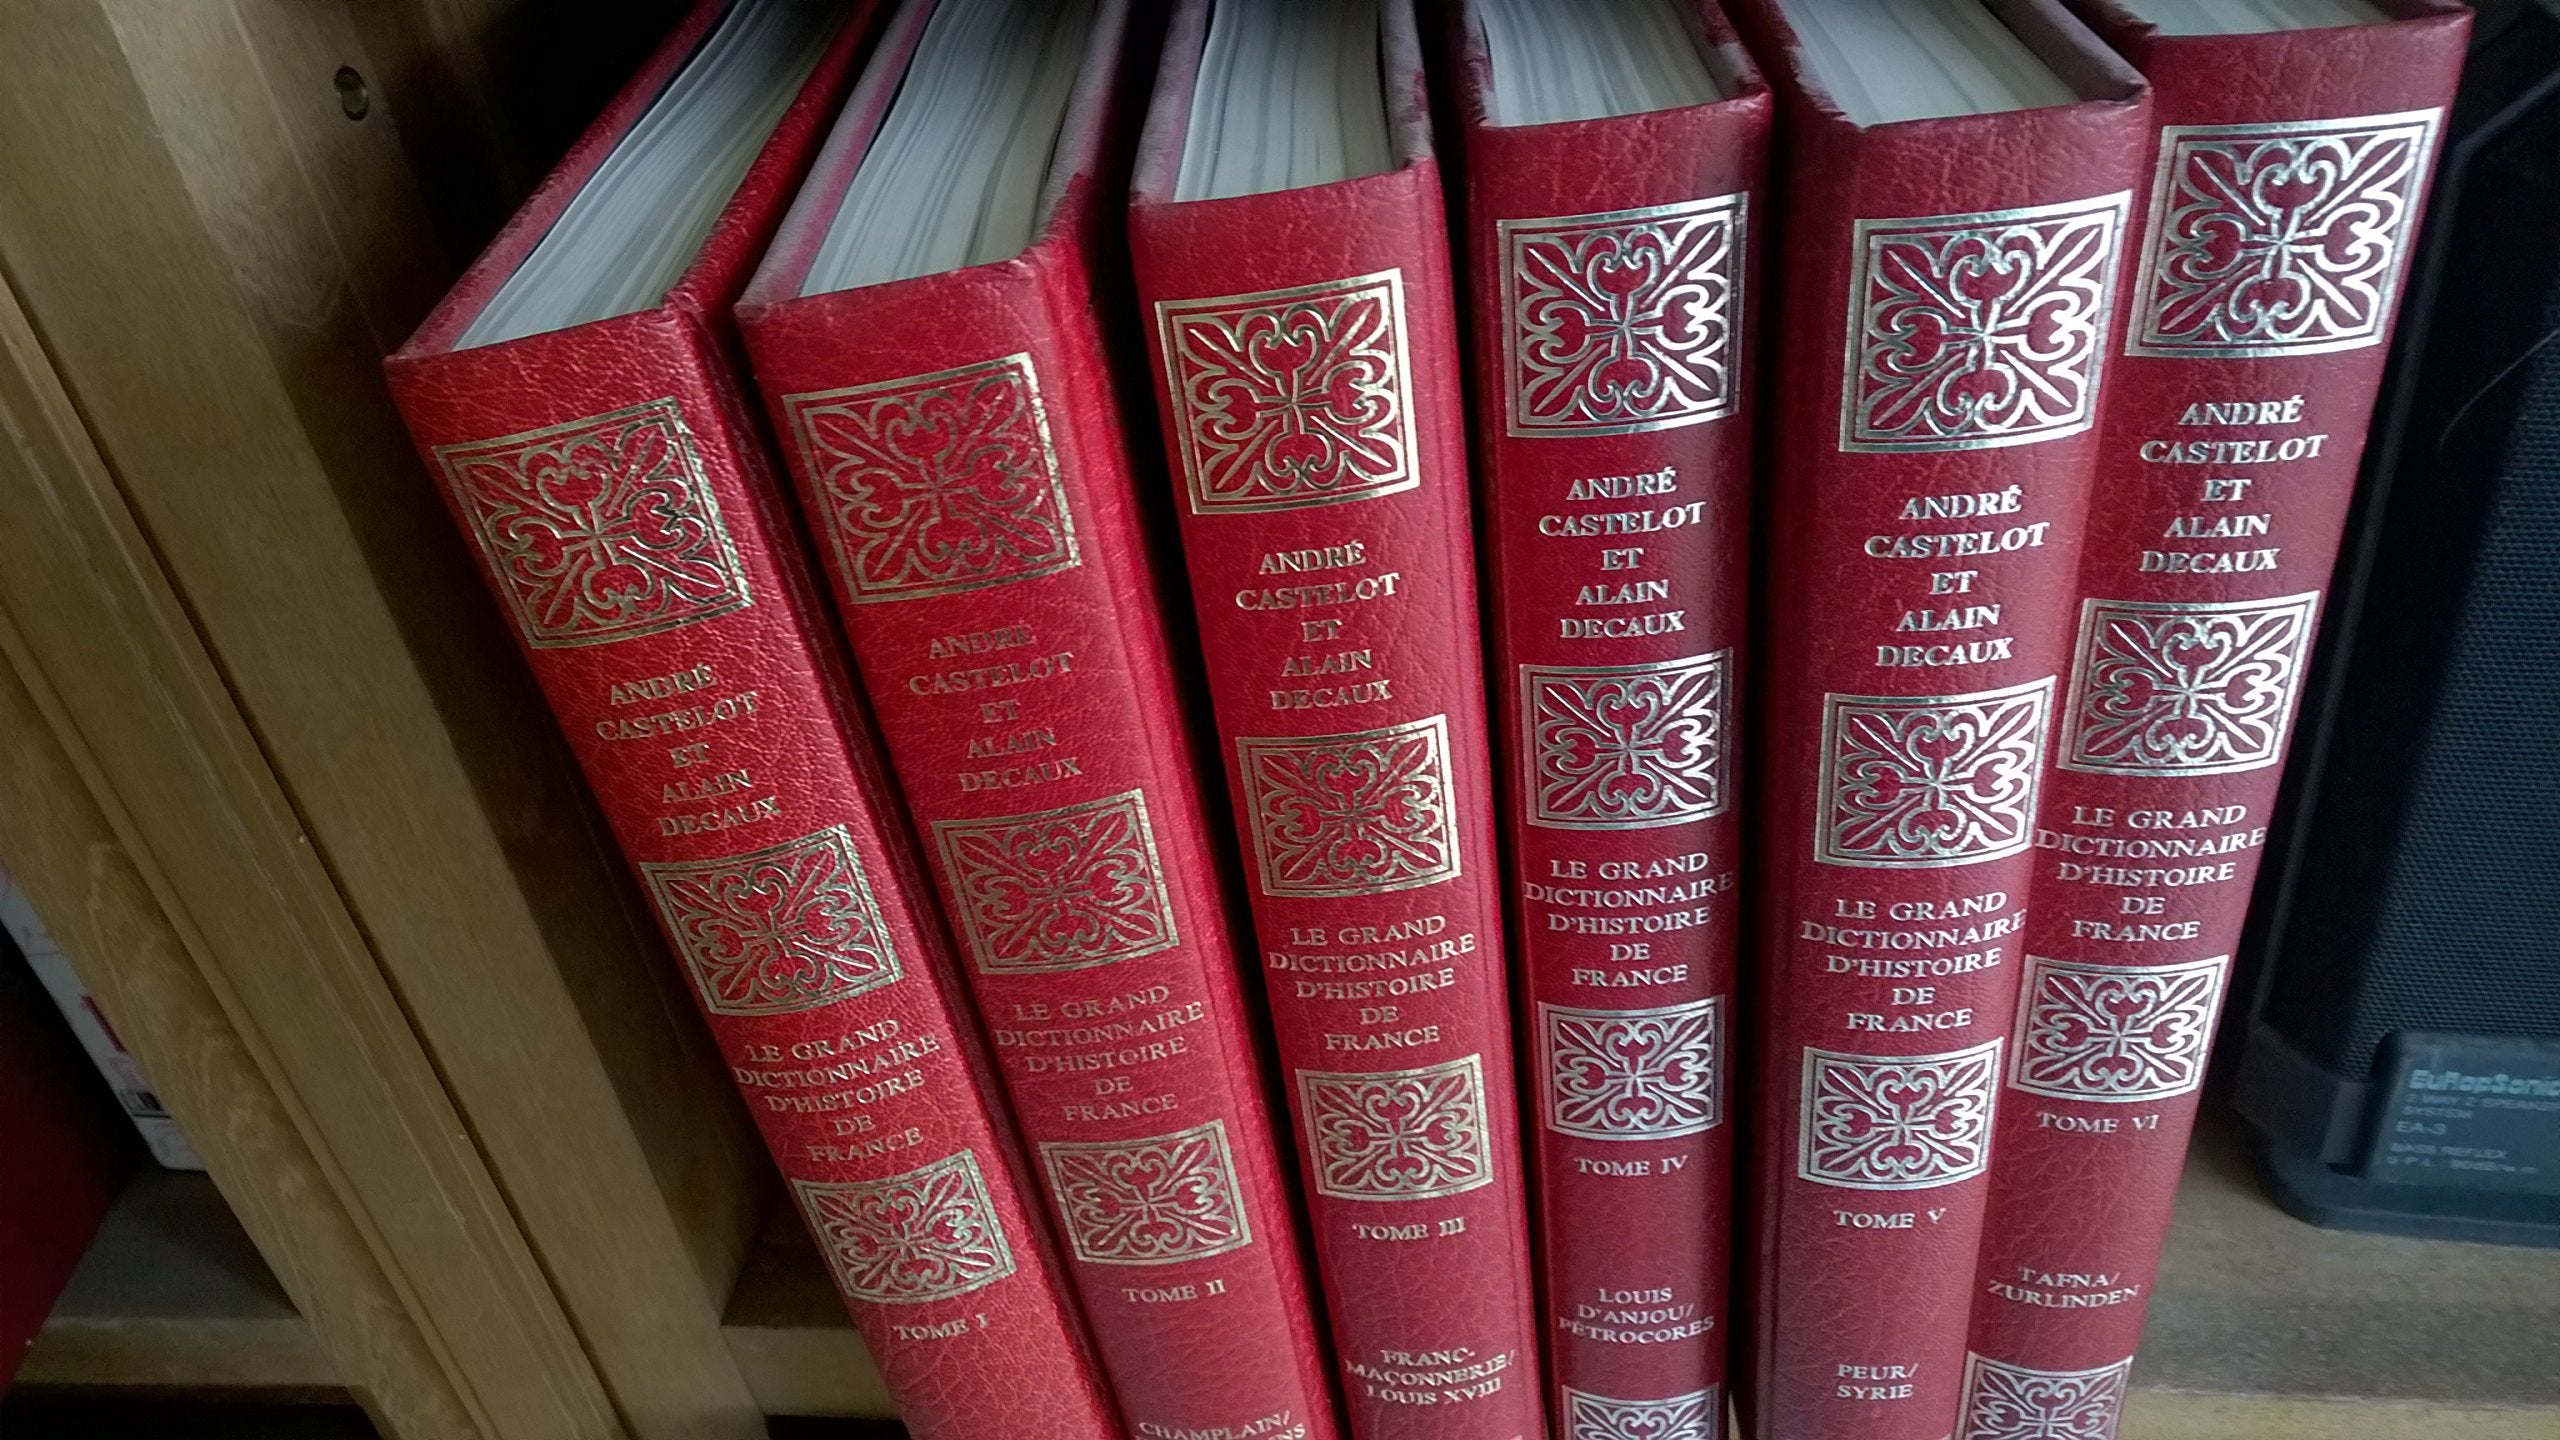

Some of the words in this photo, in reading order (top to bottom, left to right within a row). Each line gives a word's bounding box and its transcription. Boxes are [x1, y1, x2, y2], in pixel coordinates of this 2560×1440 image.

[2178, 394, 2305, 426] ANDRÉ
[2139, 434, 2329, 464] CASTELOT
[1565, 465, 1678, 501] ANDRÉ
[2201, 479, 2252, 502] ET
[1898, 484, 2023, 520] ANDRÉ
[1538, 501, 1707, 537] CASTELOT
[2163, 514, 2272, 538] ALAIN
[1864, 522, 2050, 559] CASTELOT
[1258, 539, 1367, 575] ANDRÉ
[1600, 548, 1645, 571] ET
[2139, 548, 2281, 574] DECAUX
[1235, 572, 1400, 611] CASTELOT
[1575, 579, 1670, 605] ALAIN
[1929, 570, 1978, 595] ET
[1301, 619, 1343, 643] ET
[1560, 610, 1686, 639] DECAUX
[1896, 604, 2000, 632] ALAIN
[1281, 649, 1372, 677] ALAIN
[1875, 637, 2014, 667] DECAUX
[611, 662, 718, 705] ANDRÉ
[909, 651, 1074, 695] CASTELOT
[1270, 679, 1393, 710] DECAUX
[596, 691, 758, 740] CASTELOT
[980, 699, 1021, 723] ET
[670, 742, 710, 768] ET
[967, 727, 1057, 759] ALAIN
[662, 769, 752, 803] ALAIN
[958, 756, 1083, 792] DECAUX
[657, 796, 781, 836] DECAUX
[2072, 806, 2115, 827] LE
[2127, 805, 2247, 829] GRAND
[2035, 827, 2268, 858] DICTIONNAIRE
[1550, 859, 1587, 880] LE
[1598, 852, 1709, 880] GRAND
[2057, 862, 2236, 887] D'HISTOIRE
[1523, 871, 1735, 908] DICTIONNAIRE
[1835, 898, 1877, 920] LE
[1889, 891, 2007, 921] GRAND
[2120, 897, 2166, 915] DE
[1290, 927, 1328, 947] LE
[1338, 915, 1446, 946] GRAND
[1548, 906, 1712, 936] D'HISTOIRE
[1800, 908, 2028, 950] DICTIONNAIRE
[2072, 921, 2201, 942] FRANCE
[1268, 933, 1476, 973] DICTIONNAIRE
[1610, 943, 1651, 962] DE
[1826, 947, 2002, 978] D'HISTOIRE
[1295, 967, 1456, 999] D'HISTOIRE
[1571, 964, 1689, 987] FRANCE
[1014, 1003, 1050, 1021] LE
[1061, 985, 1170, 1019] GRAND
[1891, 987, 1936, 1006] DE
[994, 1001, 1204, 1047] DICTIONNAIRE
[1359, 1005, 1399, 1025] DE
[1846, 1008, 1973, 1032] FRANCE
[746, 1044, 783, 1062] LE
[792, 1019, 900, 1061] GRAND
[1324, 1025, 1440, 1051] FRANCE
[732, 1033, 941, 1088] DICTIONNAIRE
[1025, 1036, 1188, 1073] D'HISTOIRE
[765, 1069, 926, 1113] D'HISTOIRE
[1094, 1075, 1134, 1095] DE
[1062, 1093, 1179, 1122] FRANCE
[833, 1114, 876, 1136] DE
[2036, 1113, 2120, 1133] TOME
[2131, 1114, 2160, 1131] VI
[2396, 1121, 2447, 1135] EA-3
[807, 1127, 924, 1162] FRANCE
[1574, 1158, 1651, 1177] TOME
[1661, 1155, 1689, 1174] IV
[1352, 1222, 1430, 1241] TOME
[1438, 1216, 1466, 1237] III
[1833, 1210, 1916, 1229] TOME
[1927, 1208, 1946, 1225] V
[1122, 1284, 1198, 1304] TOME
[1205, 1279, 1226, 1296] II
[2019, 1267, 2121, 1288] TAFNA/
[1599, 1287, 1673, 1305] LOUIS
[1987, 1280, 2143, 1308] ZURLINDEN
[893, 1318, 970, 1341] TOME
[974, 1312, 990, 1329] I
[1577, 1303, 1694, 1325] D'ANJOU/
[1344, 1349, 1515, 1387] MAÇONNERIE/
[1380, 1347, 1475, 1367] FRANC-
[1837, 1363, 1919, 1381] PEUR/
[1366, 1384, 1437, 1405] LOUIS
[1443, 1377, 1502, 1405] XVIII
[1837, 1384, 1913, 1401] SYRIE
